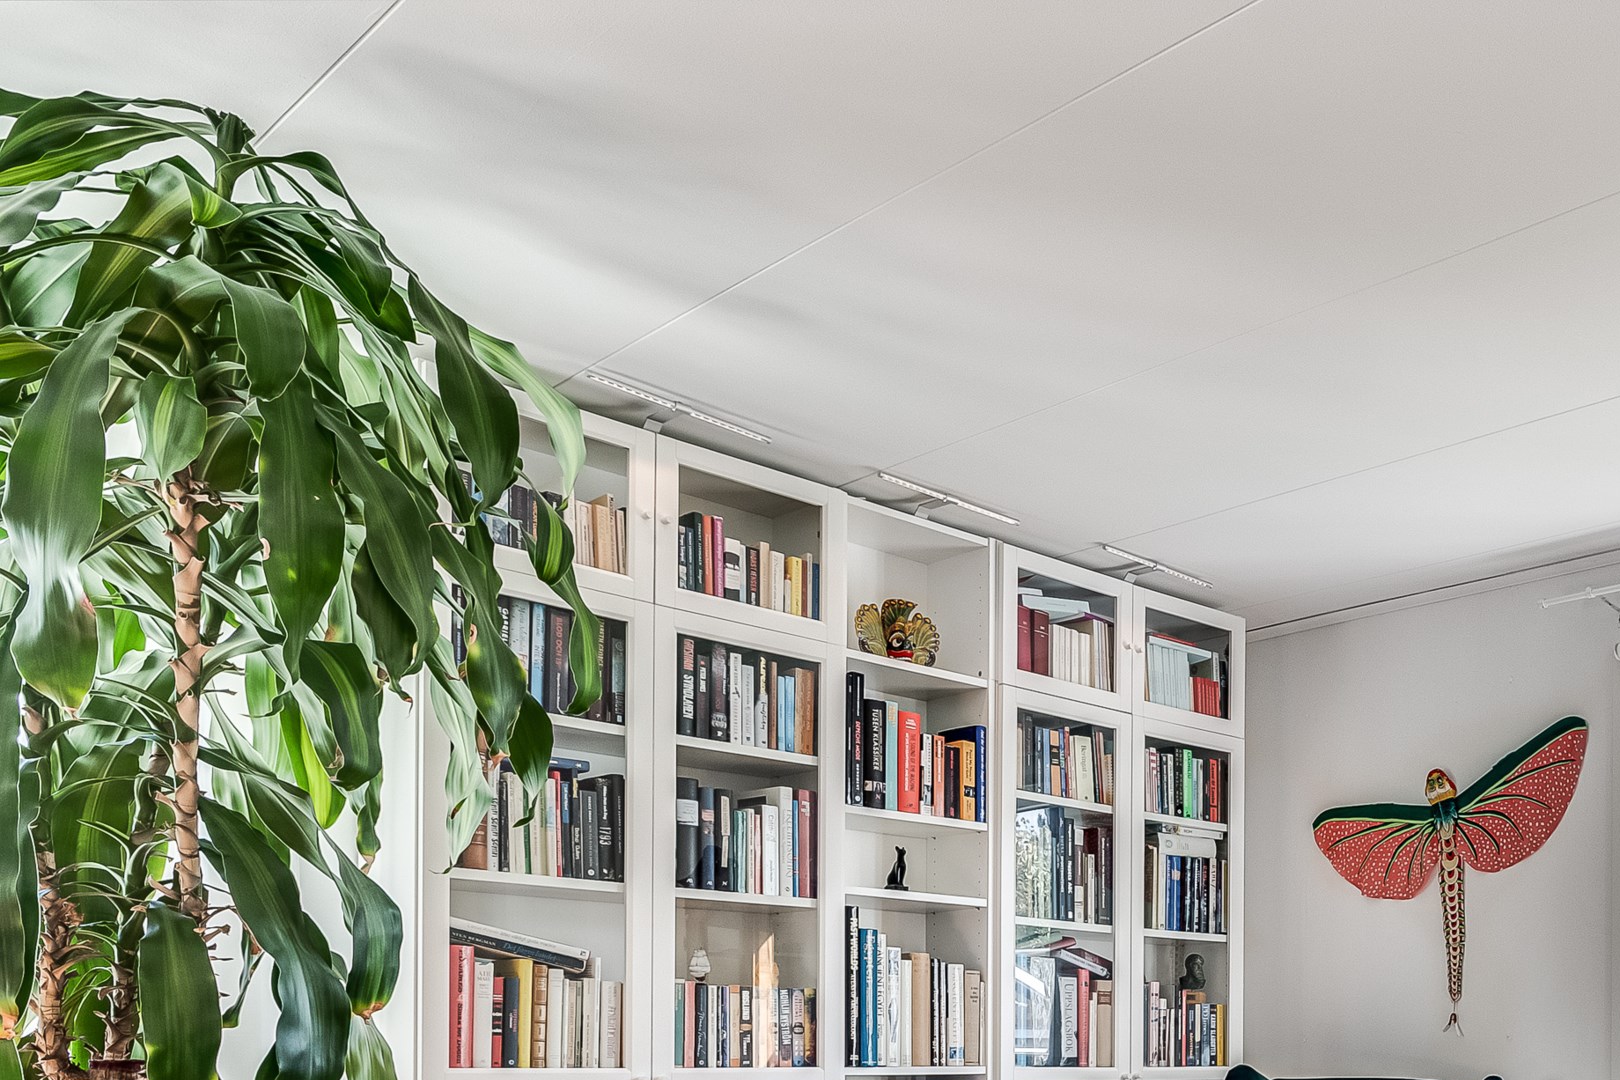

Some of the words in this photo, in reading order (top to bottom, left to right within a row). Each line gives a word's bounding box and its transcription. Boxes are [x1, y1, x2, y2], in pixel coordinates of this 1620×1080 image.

[600, 826, 611, 846] 1793
[850, 918, 858, 935] PAST
[850, 936, 858, 970] WORLDS
[1064, 983, 1074, 1052] UPPSLAGSBOK
